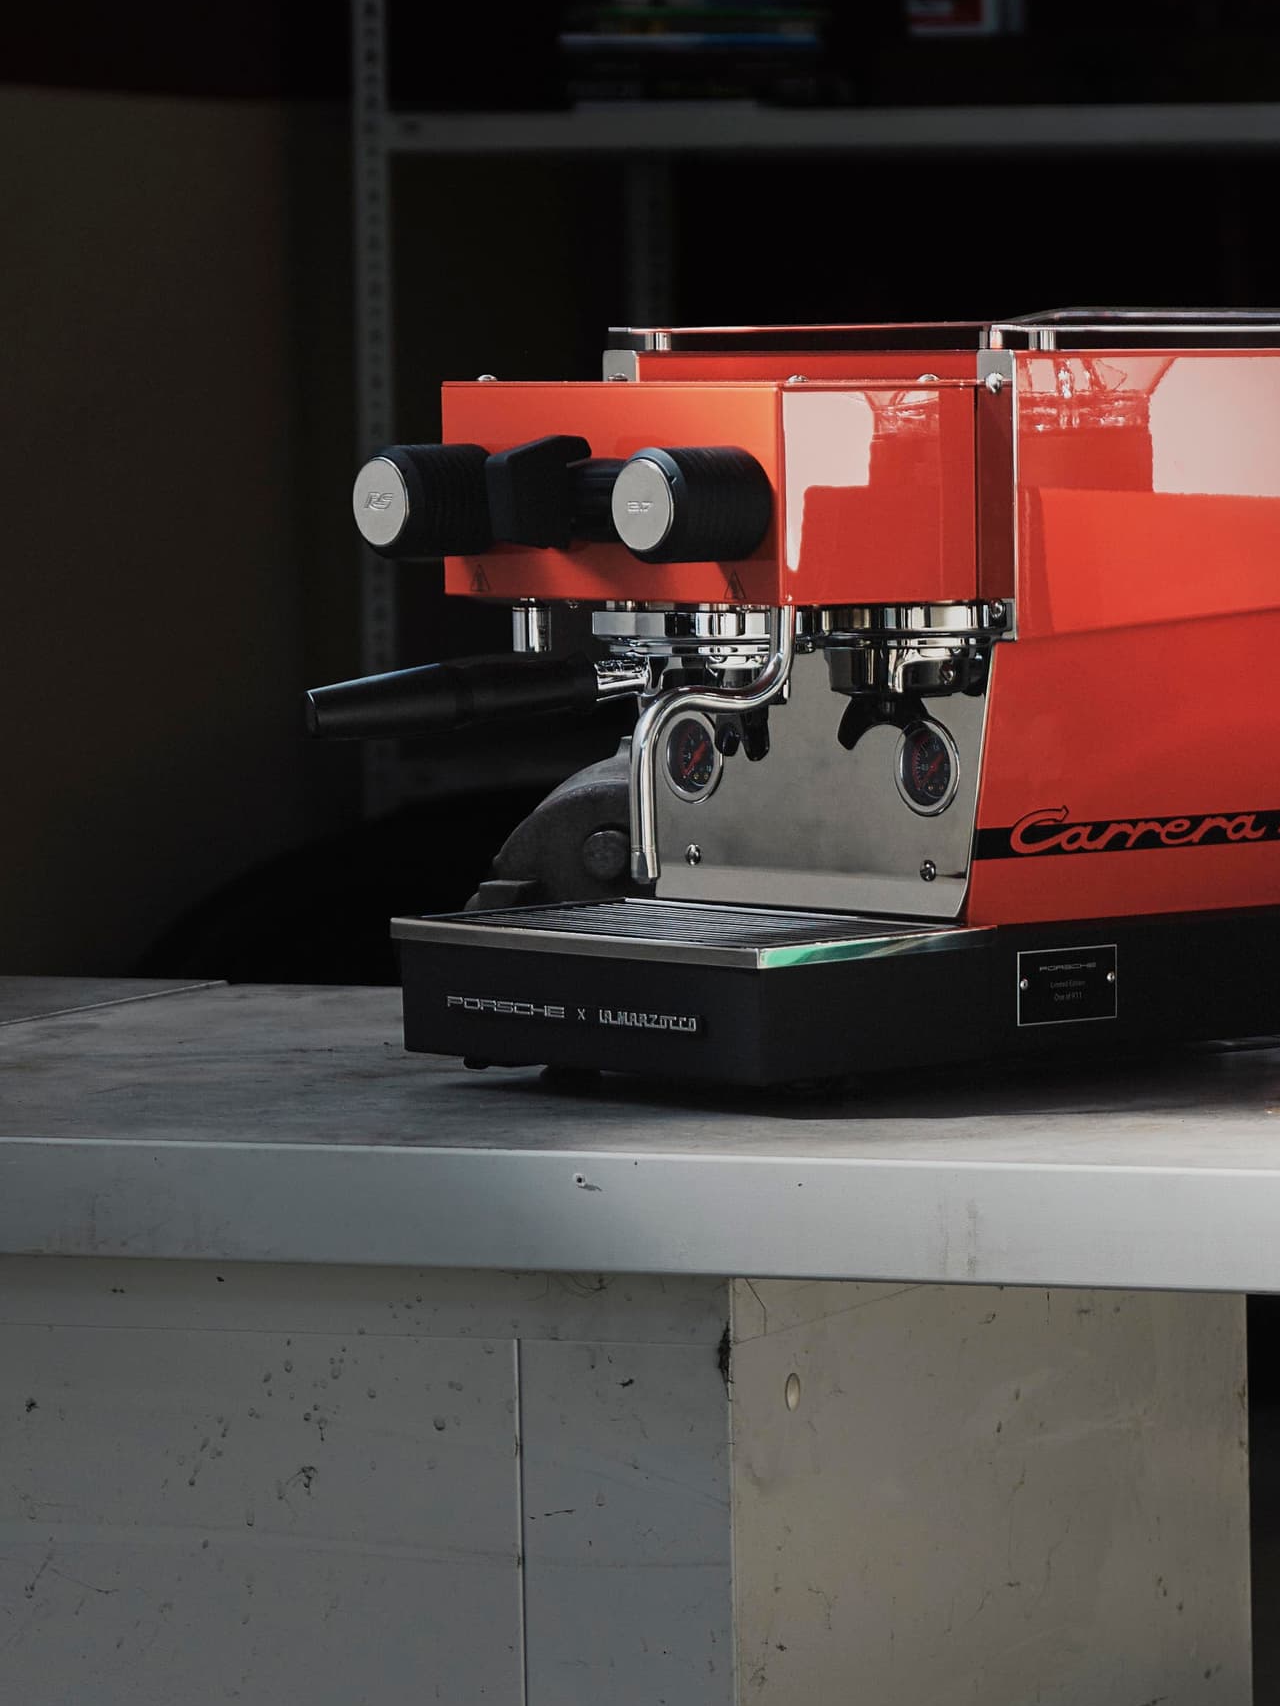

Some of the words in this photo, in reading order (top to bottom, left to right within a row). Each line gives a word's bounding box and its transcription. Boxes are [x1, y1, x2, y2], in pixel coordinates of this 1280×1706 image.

[363, 491, 394, 511] RS
[1009, 804, 1267, 854] Carrera
[1040, 962, 1097, 972] PORSCHE
[447, 995, 565, 1019] PORSCHE
